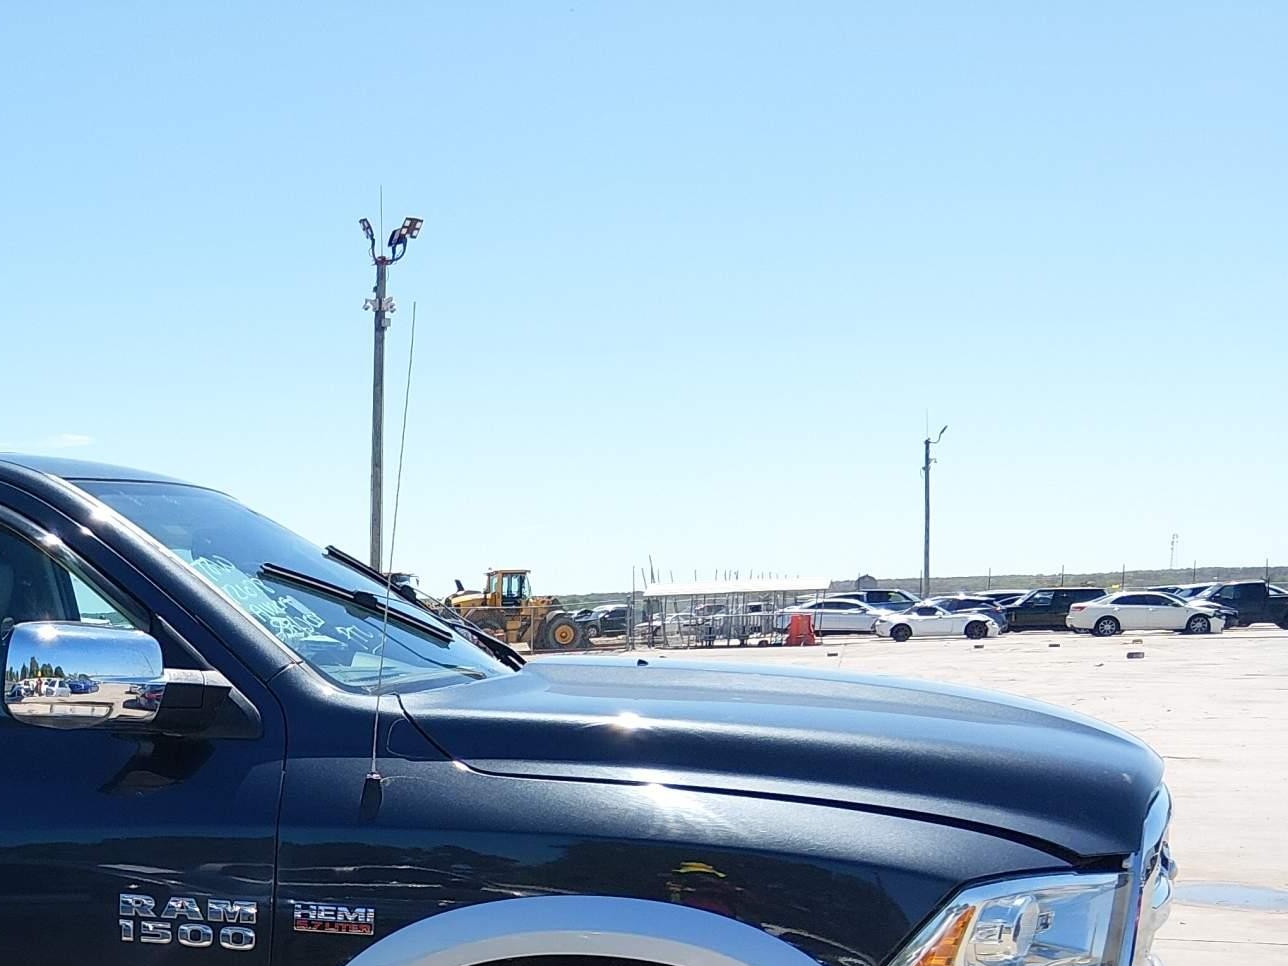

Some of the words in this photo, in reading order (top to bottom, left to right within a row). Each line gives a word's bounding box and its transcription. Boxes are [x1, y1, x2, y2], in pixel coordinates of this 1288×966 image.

[119, 893, 258, 925] RAM
[294, 903, 375, 922] HEMI
[119, 919, 257, 951] 1500
